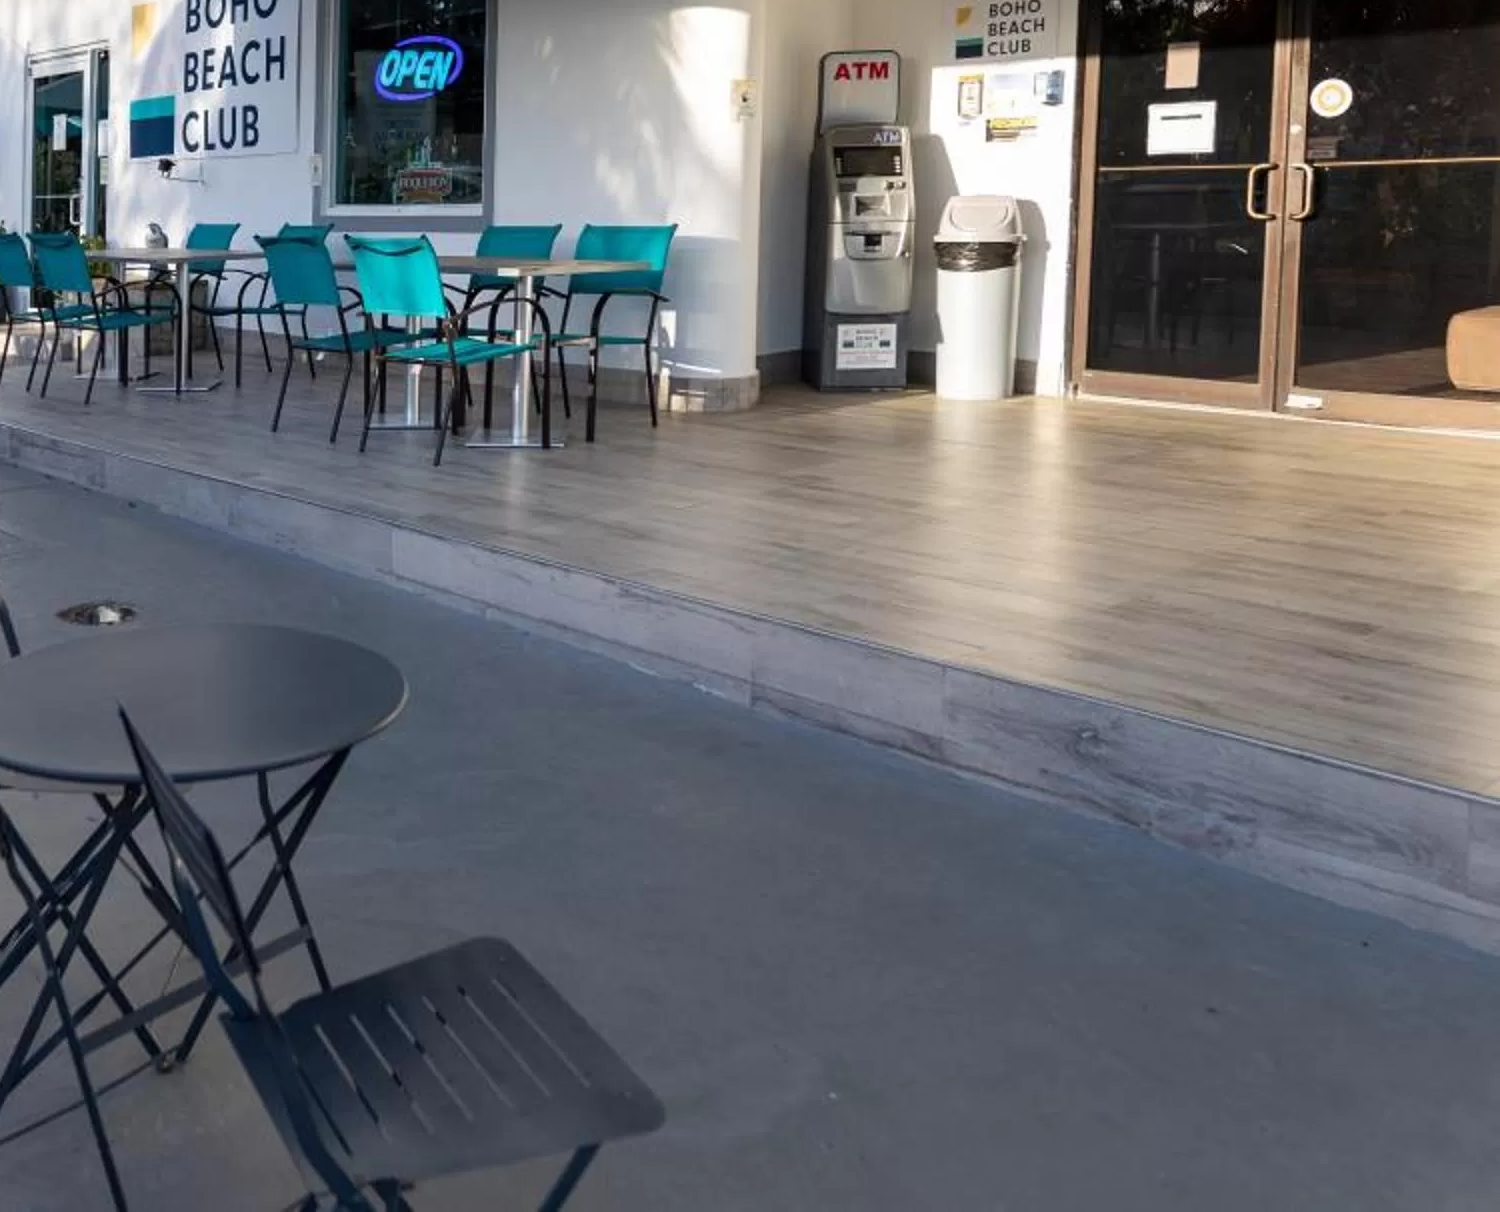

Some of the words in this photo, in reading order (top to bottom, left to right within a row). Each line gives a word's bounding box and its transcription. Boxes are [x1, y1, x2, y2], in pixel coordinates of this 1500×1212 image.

[989, 0, 1041, 18] BOHO
[987, 18, 1045, 37] BEACH
[987, 39, 1031, 56] CLUB
[183, 35, 286, 93] BEACH
[380, 49, 455, 91] OPEN
[833, 61, 889, 81] ATM
[182, 104, 260, 153] CLUB
